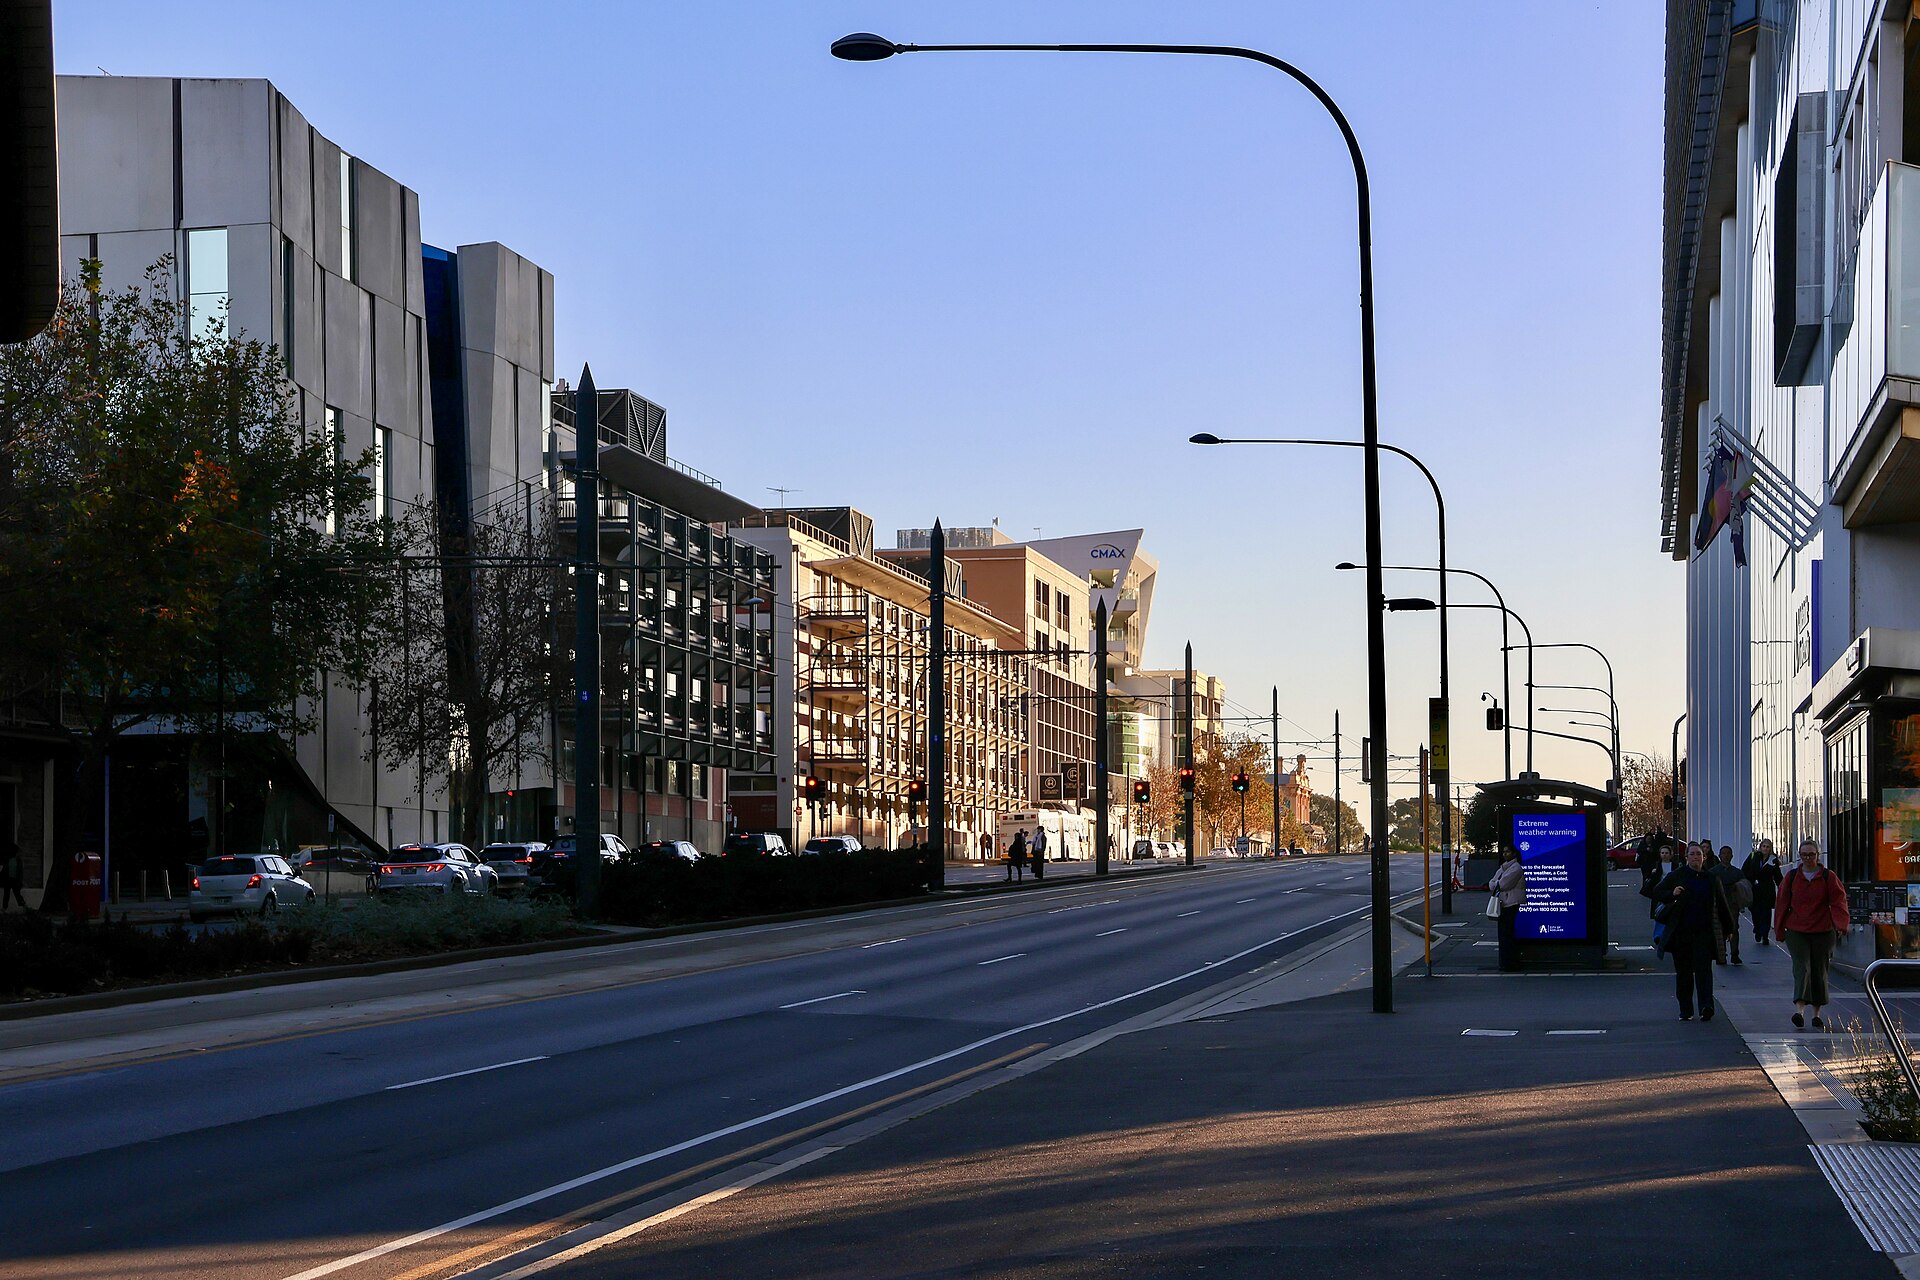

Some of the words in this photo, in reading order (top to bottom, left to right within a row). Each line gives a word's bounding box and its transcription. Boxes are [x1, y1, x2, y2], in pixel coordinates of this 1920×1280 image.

[1091, 549, 1125, 558] CMAX
[1432, 745, 1446, 756] C1
[1518, 828, 1547, 836] weather
[1548, 828, 1577, 837] warning
